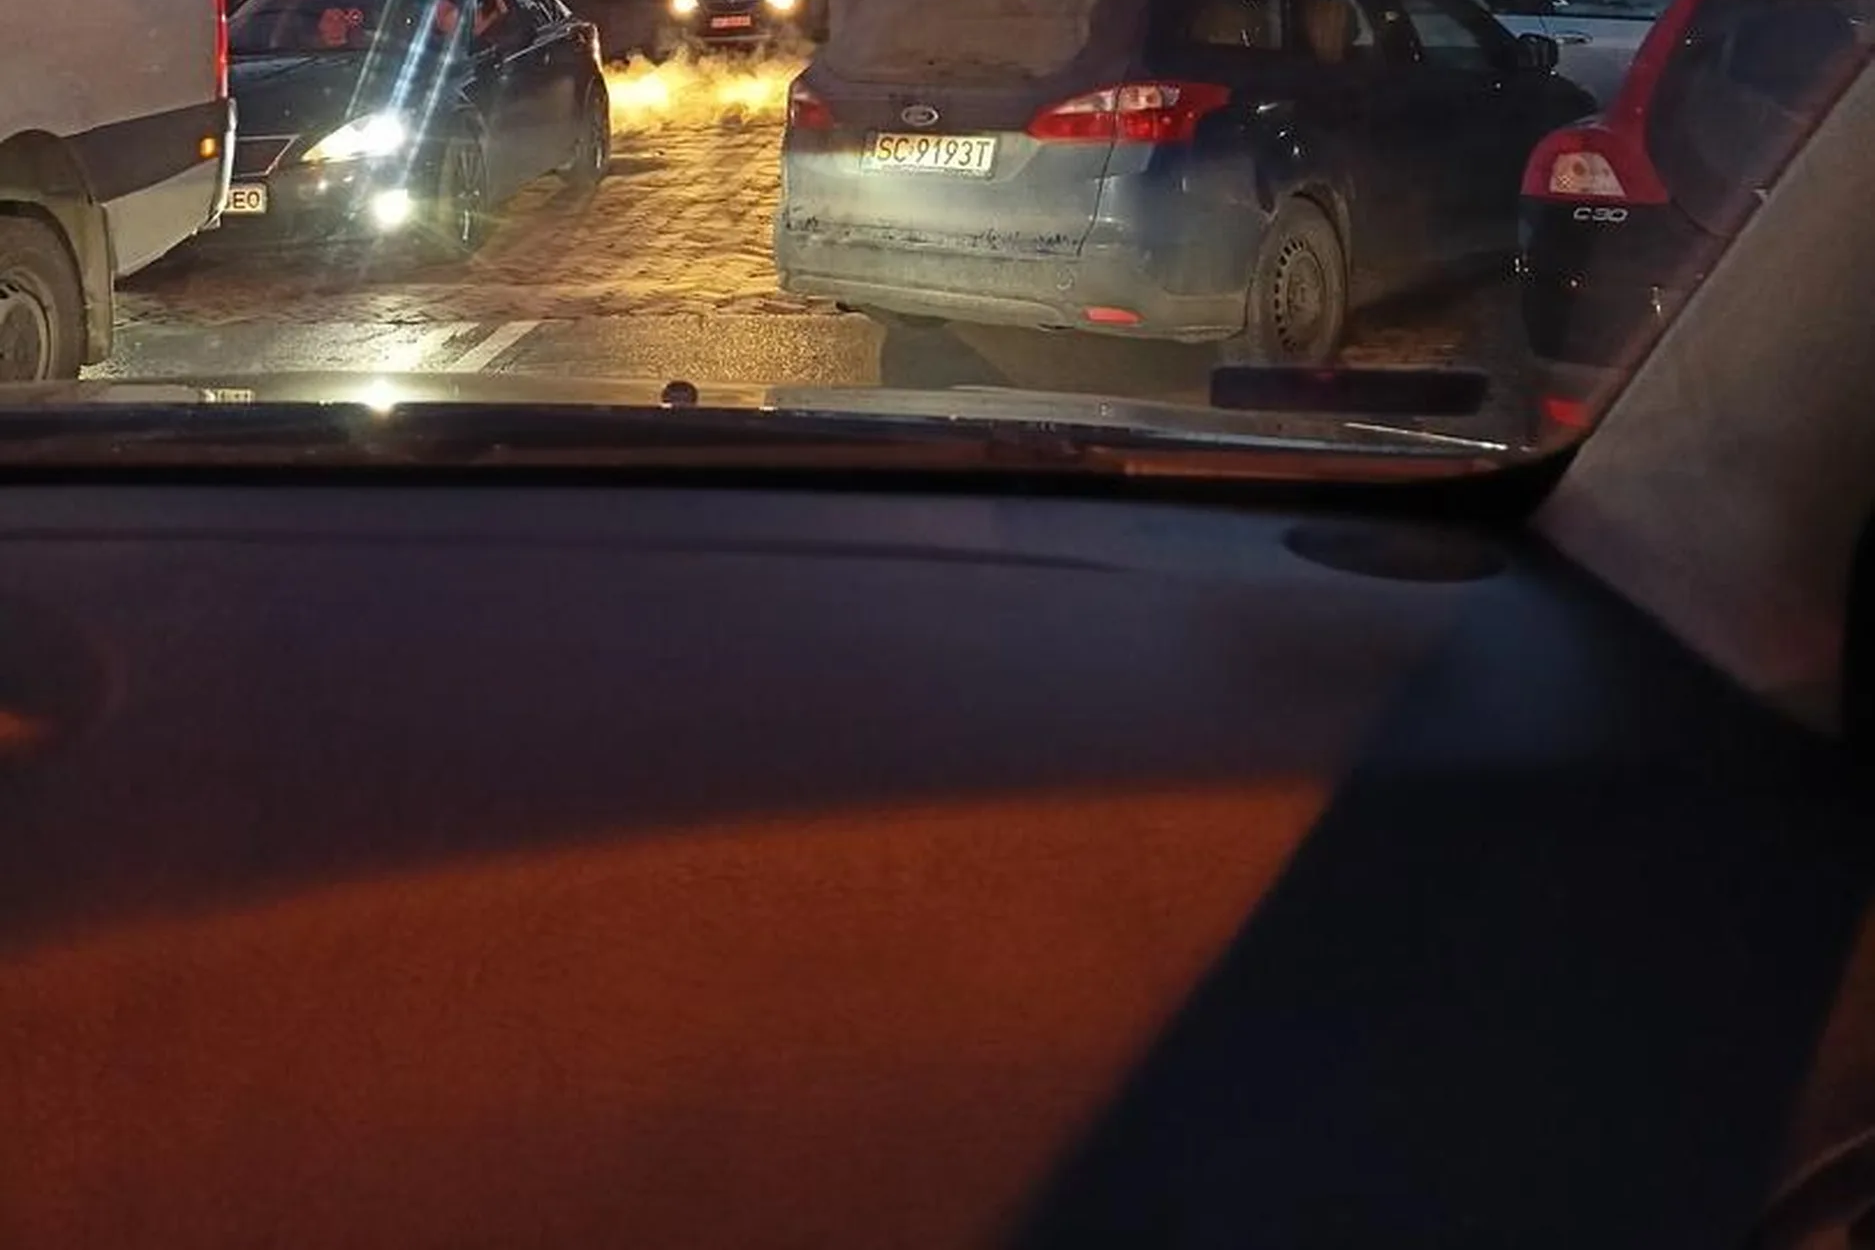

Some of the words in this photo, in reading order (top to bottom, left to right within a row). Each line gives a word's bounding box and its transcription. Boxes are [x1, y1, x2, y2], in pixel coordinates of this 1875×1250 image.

[877, 136, 909, 163] SC
[915, 138, 990, 167] 9193T
[1573, 207, 1628, 222] C30
